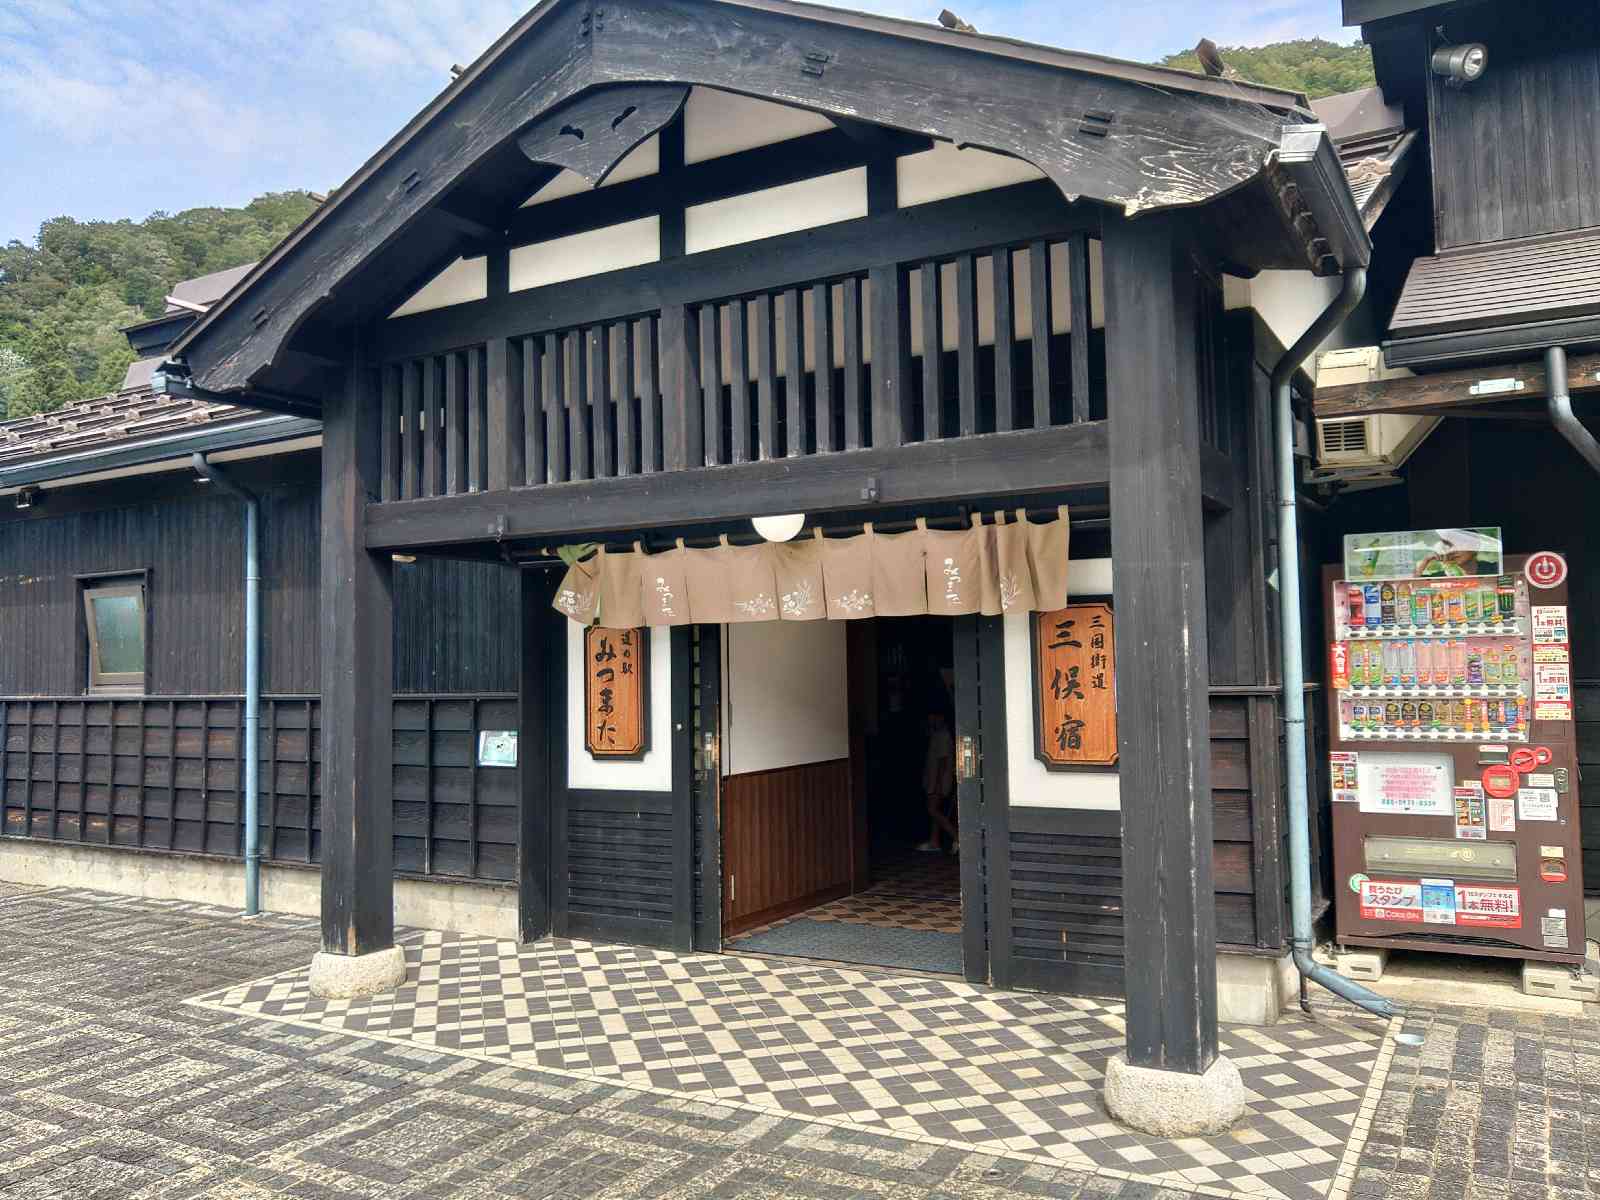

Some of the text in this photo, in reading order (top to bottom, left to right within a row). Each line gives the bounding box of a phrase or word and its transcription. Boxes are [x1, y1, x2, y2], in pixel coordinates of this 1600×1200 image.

[595, 635, 617, 746] みつまた
[1368, 894, 1416, 912] スタンプ
